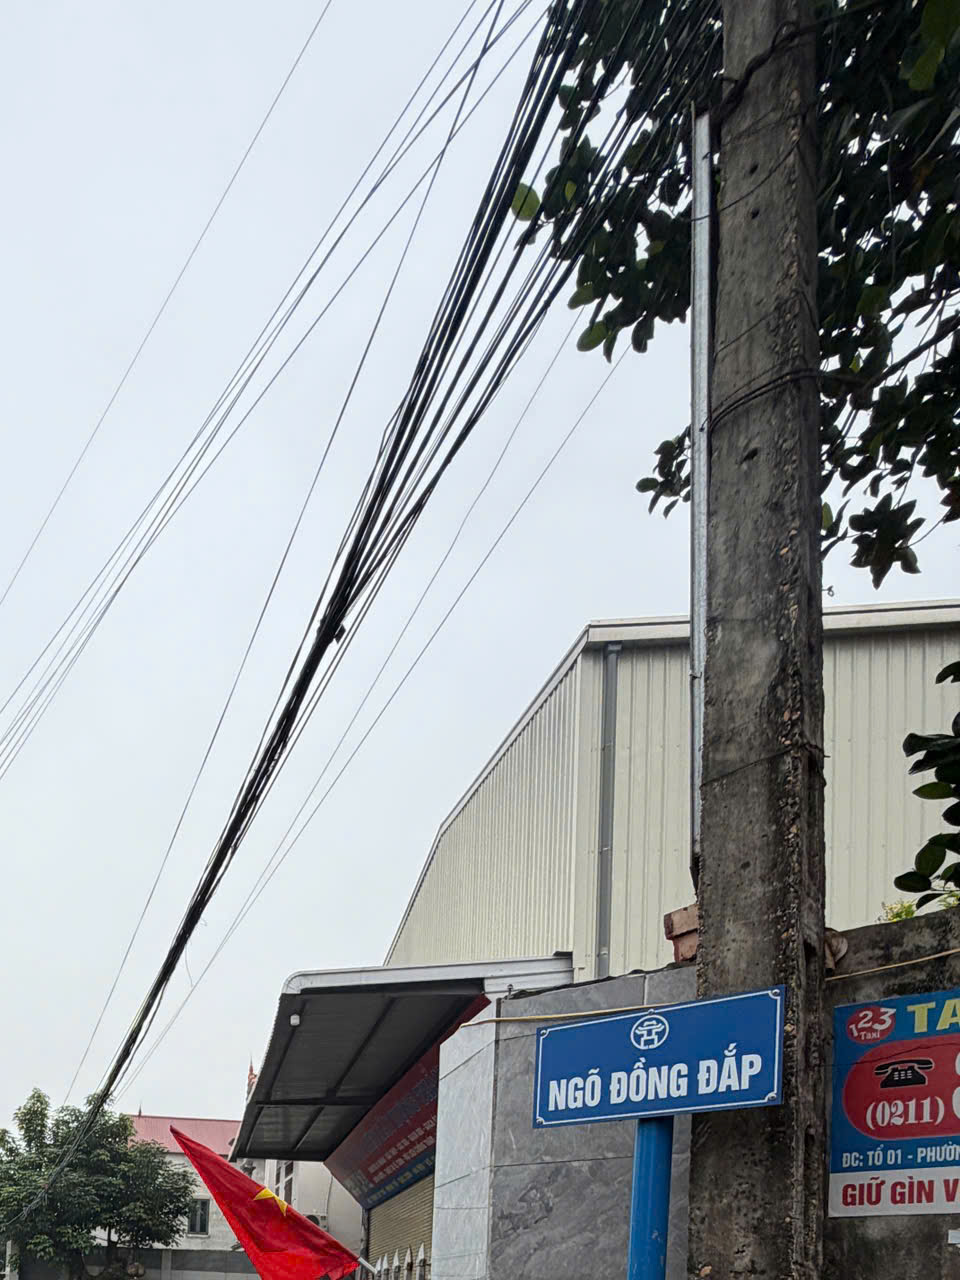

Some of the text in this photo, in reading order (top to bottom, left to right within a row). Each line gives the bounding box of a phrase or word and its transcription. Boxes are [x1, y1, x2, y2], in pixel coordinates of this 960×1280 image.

[548, 1042, 762, 1111] NGÕ ĐỒNG ĐẮP
[865, 1096, 945, 1130] (0211)
[842, 1151, 864, 1168] ĐC:
[886, 1149, 902, 1165] 01
[842, 1177, 886, 1207] GIỮ
[889, 1176, 934, 1205] GÌN
